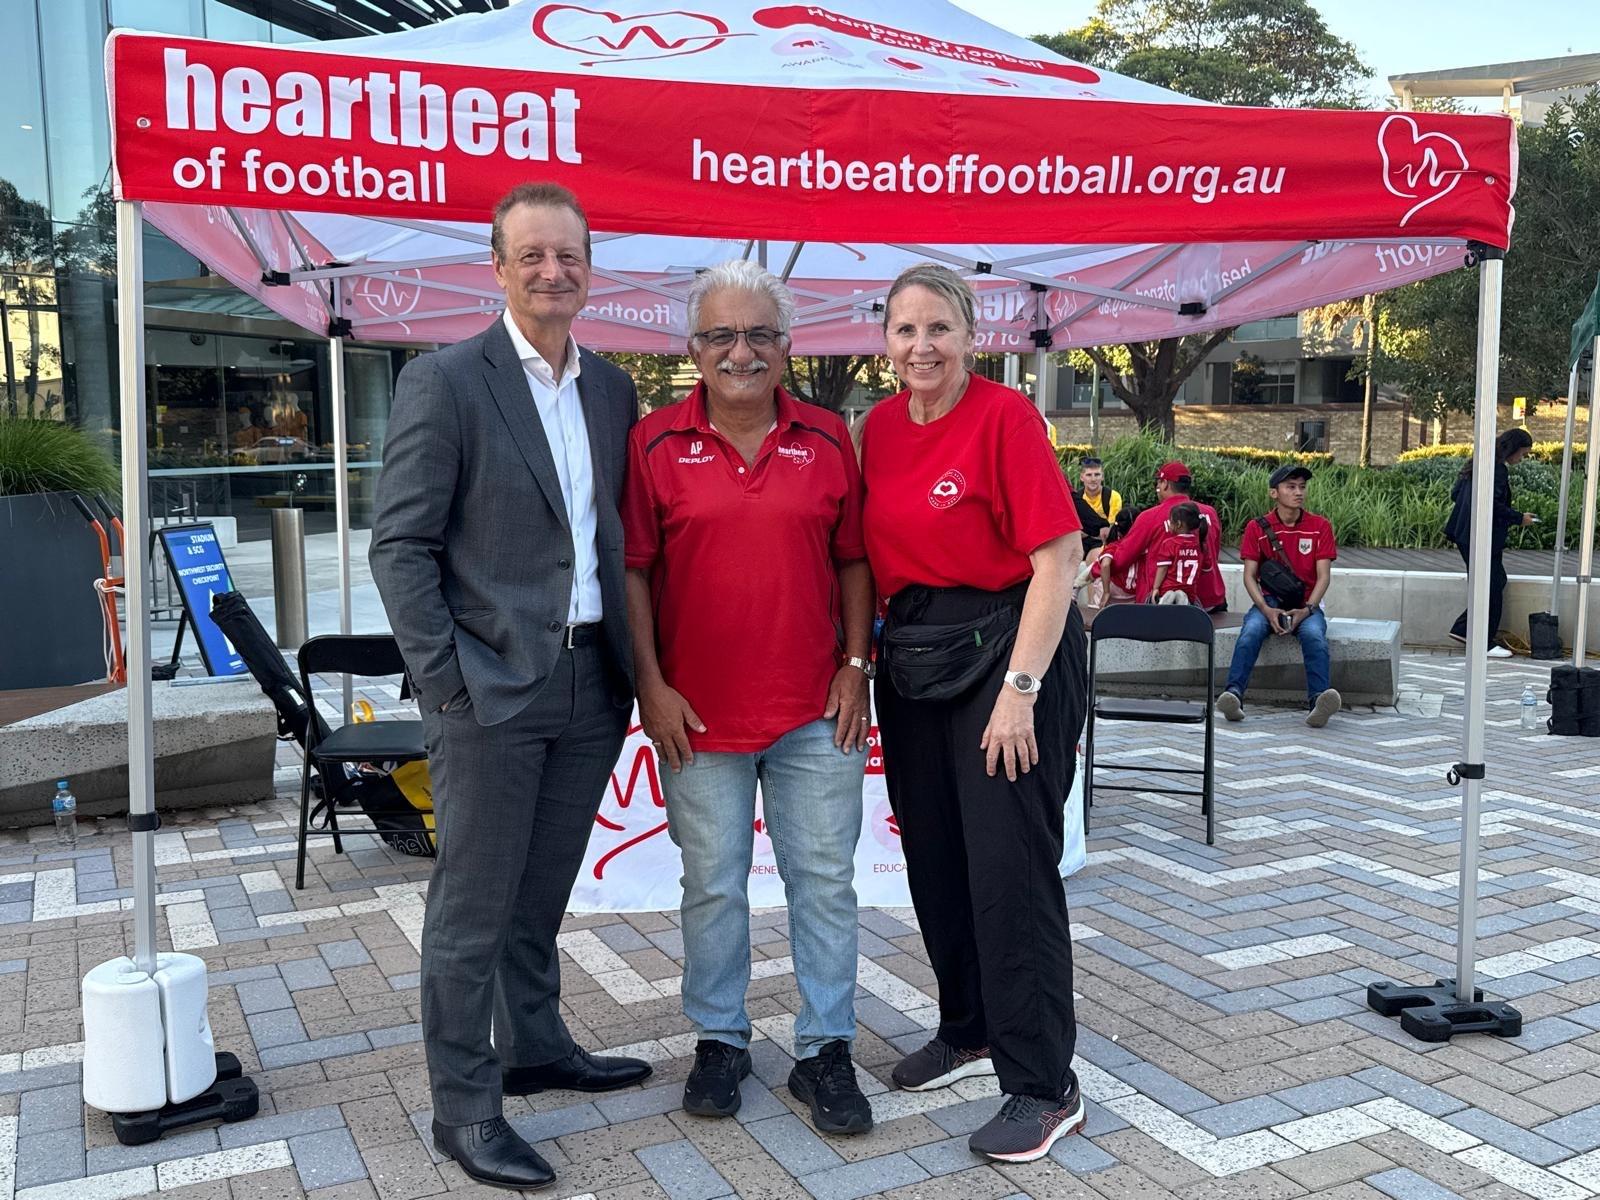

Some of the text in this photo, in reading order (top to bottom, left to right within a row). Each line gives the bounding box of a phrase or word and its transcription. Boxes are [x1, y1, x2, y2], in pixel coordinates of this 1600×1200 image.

[807, 7, 1044, 70] Heartbeat of Football
[869, 32, 996, 67] Foundation
[164, 47, 582, 165] heartbeat
[172, 146, 447, 204] of football
[692, 138, 1286, 204] heartbeatoffootball.org.au
[690, 440, 703, 456] AP
[777, 445, 808, 457] heartbeat
[678, 454, 716, 464] DEPLOY
[190, 533, 216, 544] STADIUM
[205, 563, 225, 573] SECURITY
[1176, 559, 1199, 586] 17
[192, 574, 220, 585] CHECKPOINT
[873, 863, 907, 873] EDUCA
